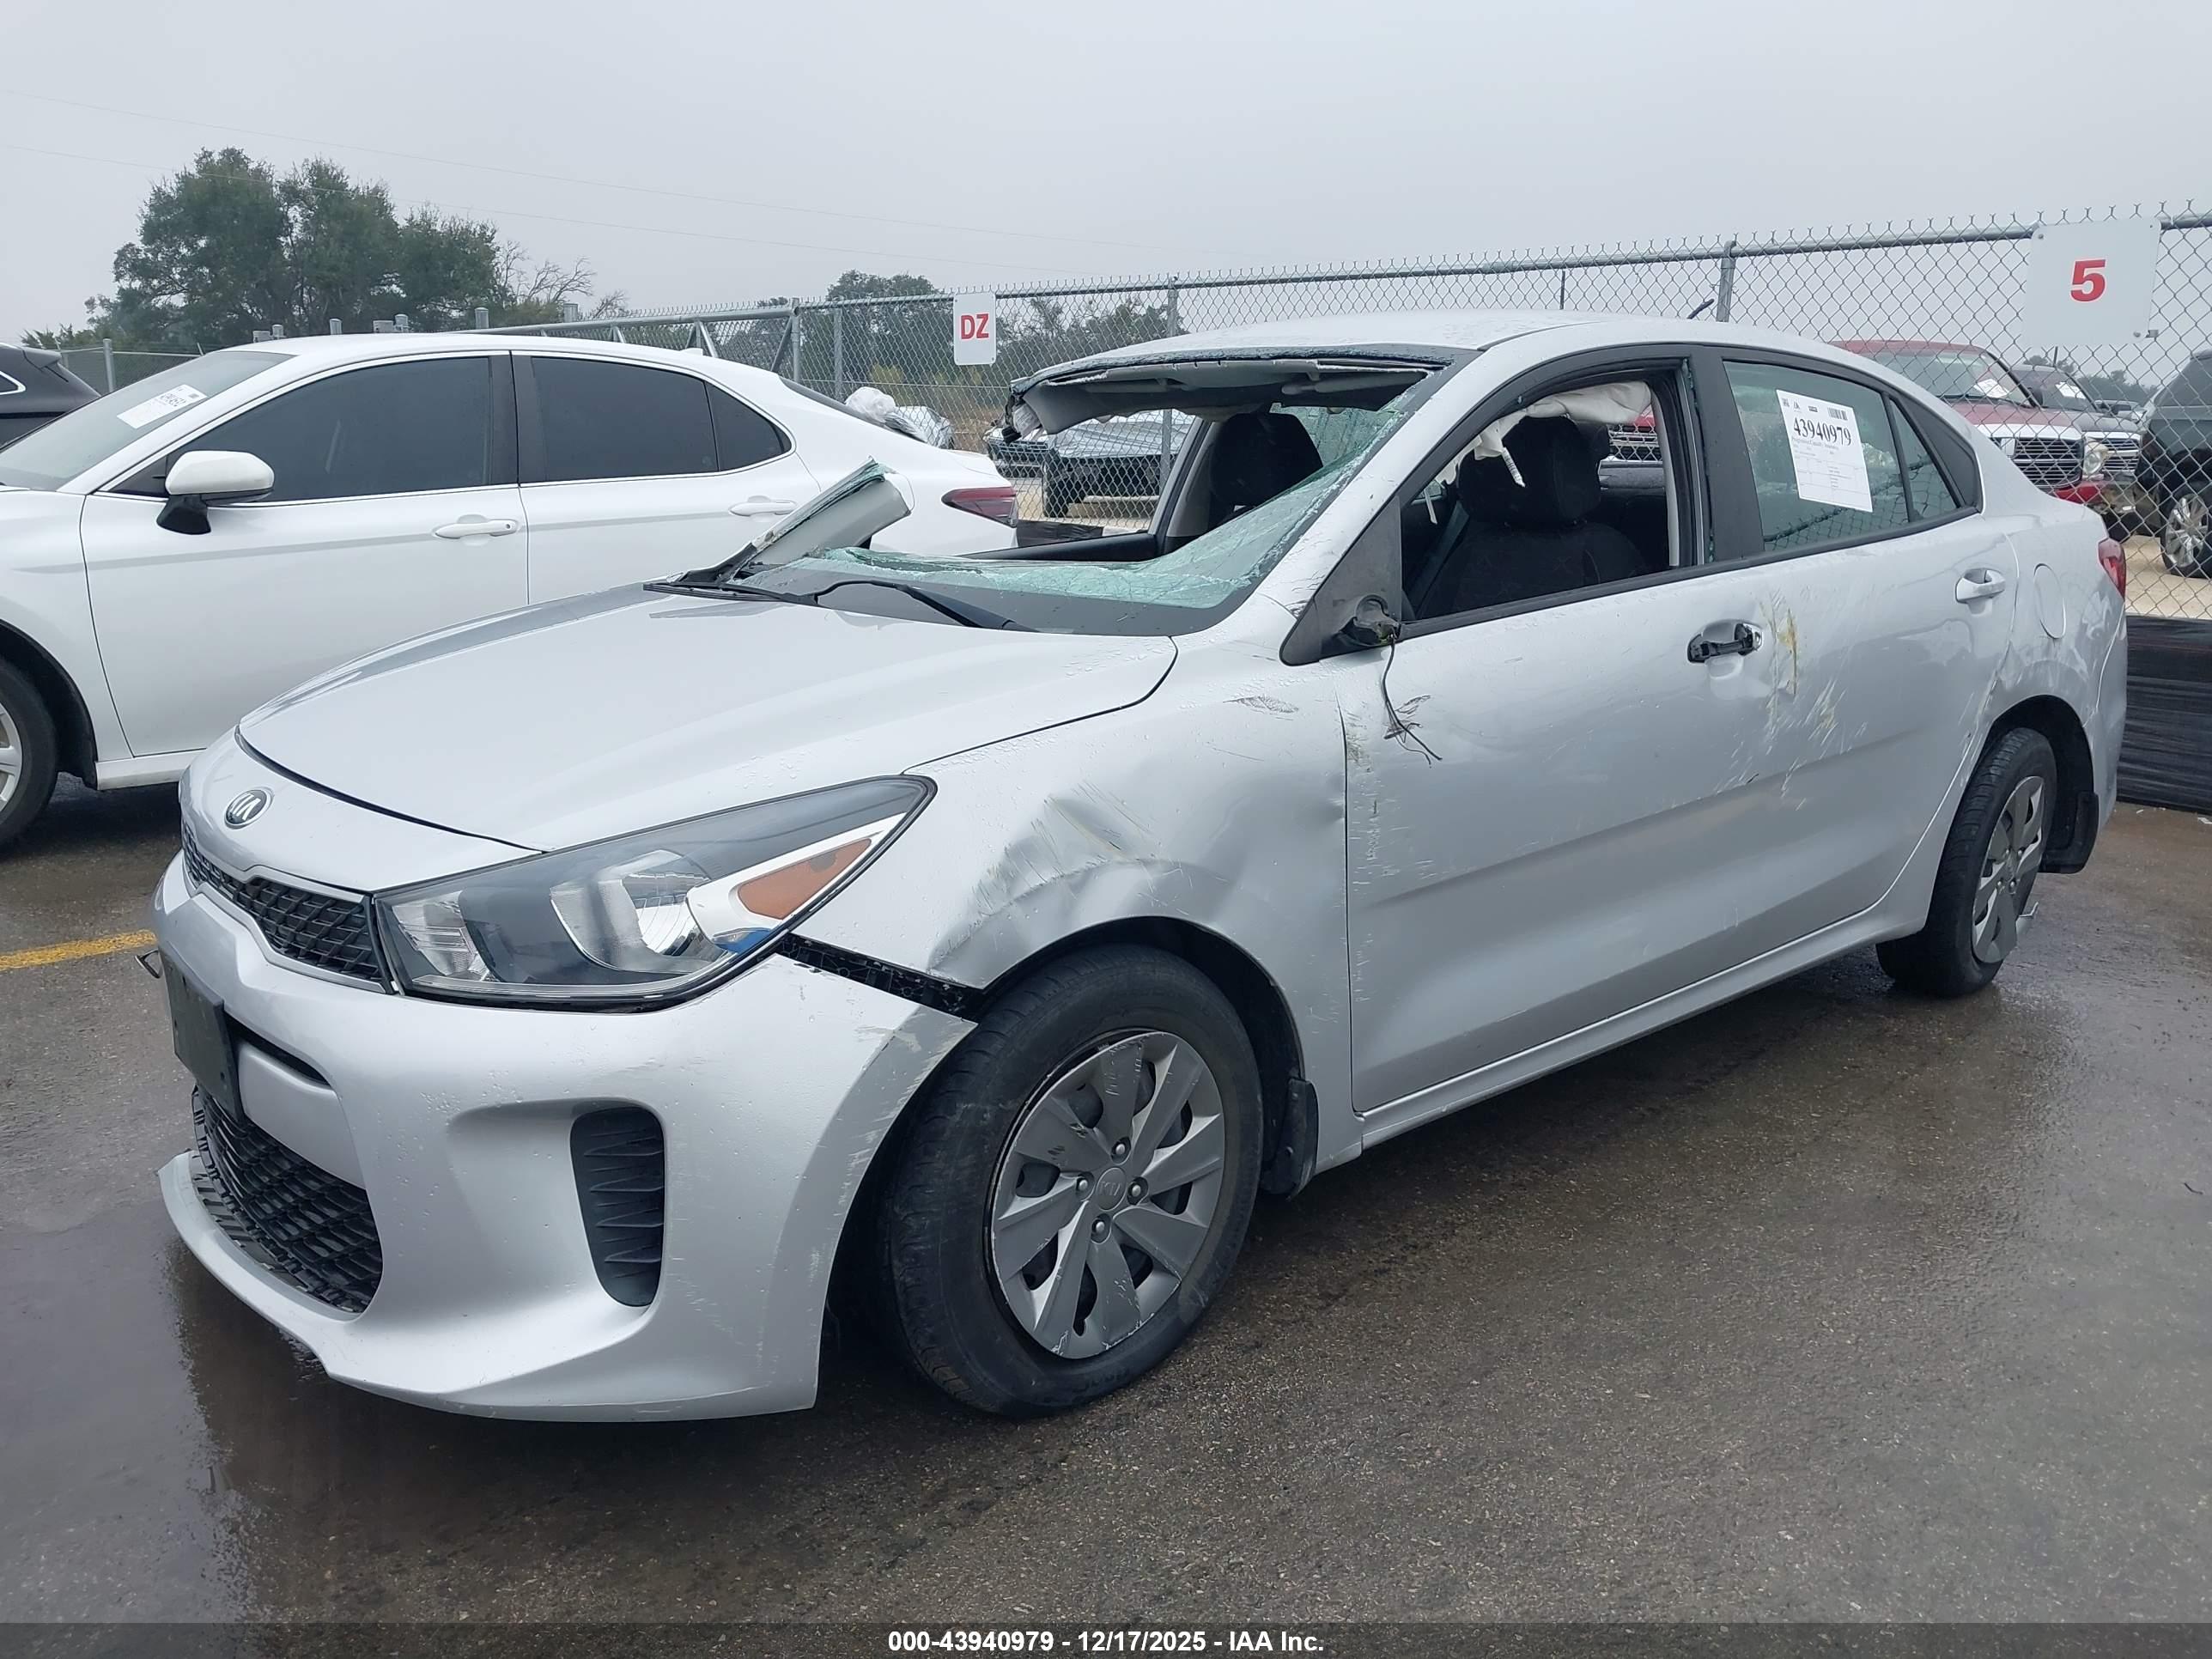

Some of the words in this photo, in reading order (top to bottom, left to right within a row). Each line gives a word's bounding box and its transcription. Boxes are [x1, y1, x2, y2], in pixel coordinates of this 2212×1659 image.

[2070, 258, 2106, 302] 5
[961, 313, 989, 340] DZ
[1793, 416, 1852, 447] 43940979
